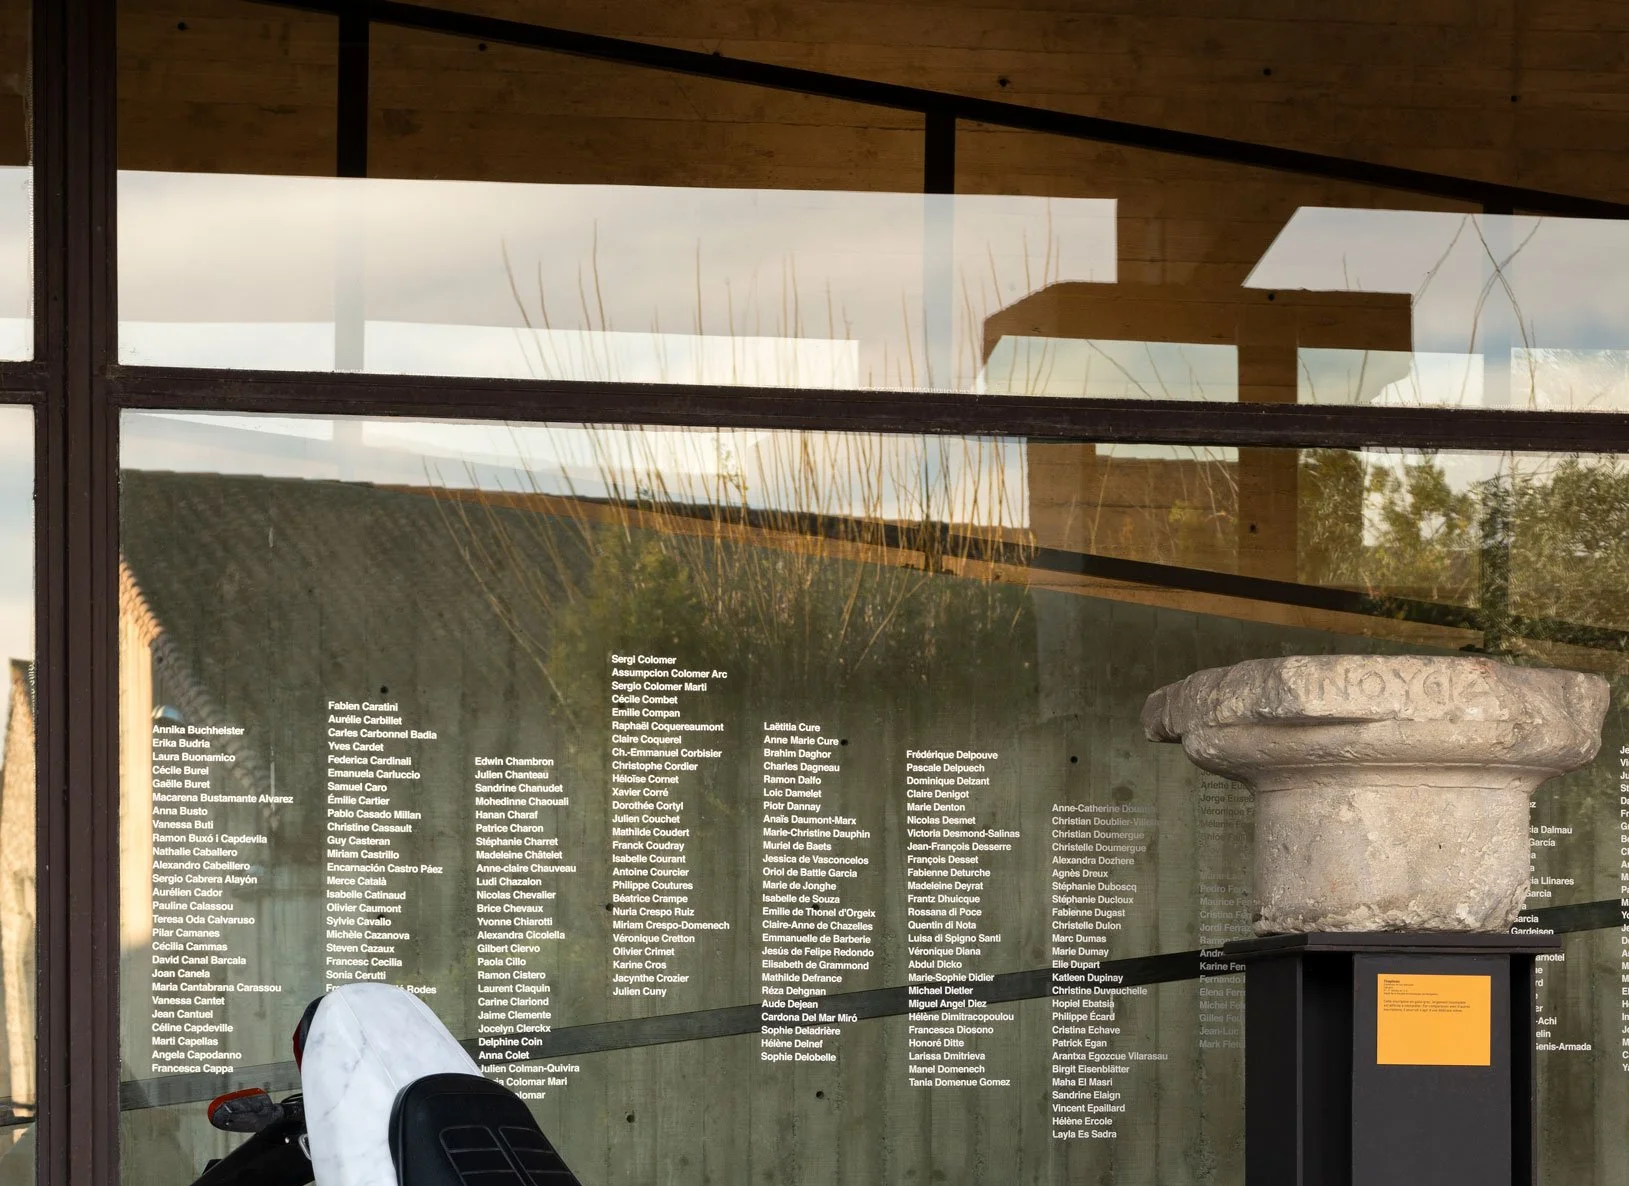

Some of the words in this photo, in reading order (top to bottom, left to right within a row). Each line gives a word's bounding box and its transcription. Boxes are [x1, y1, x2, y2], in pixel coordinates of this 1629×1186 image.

[612, 655, 635, 665] Sergi
[638, 656, 676, 664] Colomer
[612, 682, 641, 692] Sergio
[644, 683, 682, 691] Colomer
[685, 683, 707, 691] Marti
[328, 702, 360, 710] Fabien
[362, 702, 398, 711] Caratini
[153, 725, 185, 734] Annika
[188, 726, 244, 735] Buchheister
[612, 722, 649, 732] Raphaël
[651, 722, 724, 733] Coquereaumont
[764, 736, 788, 744] Anne
[791, 737, 815, 745] Marie
[153, 752, 179, 761] Laura
[182, 753, 235, 762] Buonamico
[612, 748, 678, 757] Ch.-Emmanuel
[681, 749, 722, 757] Corbisier
[907, 751, 954, 760] Frédérique
[957, 751, 998, 761] Delpouve
[328, 756, 368, 764] Federica
[370, 756, 411, 765] Cardinali
[475, 757, 503, 765] Edwin
[506, 758, 554, 766] Chambron
[764, 763, 798, 771] Charles
[801, 763, 839, 773] Dagneau
[153, 779, 182, 788] Gaëlle
[185, 780, 210, 788] Buret
[613, 775, 646, 783] Héloïse
[648, 775, 679, 783] Cornet
[907, 777, 955, 786] Dominique
[957, 777, 989, 785] Delzant
[328, 782, 362, 791] Samuel
[365, 783, 387, 791] Caro
[475, 784, 516, 792] Sandrine
[519, 784, 563, 792] Chanudet
[153, 793, 198, 802] Macarena
[201, 794, 257, 803] Bustamante
[259, 795, 293, 803] Alvarez
[763, 815, 789, 823] Anaïs
[792, 816, 856, 825] Daumont-Marx
[943, 817, 976, 825] Desmet
[328, 822, 369, 832] Christine
[372, 823, 412, 832] Cassault
[1541, 826, 1572, 834] Dalmau
[1052, 830, 1091, 838] Christian
[476, 837, 522, 847] Stéphanie
[524, 838, 558, 846] Charret
[613, 841, 643, 849] Franck
[646, 842, 684, 851] Coudray
[153, 847, 190, 855] Nathalie
[193, 848, 237, 856] Caballero
[907, 843, 970, 852] Jean-François
[972, 843, 1011, 851] Desserre
[763, 855, 796, 863] Jessica
[799, 855, 810, 863] de
[813, 856, 869, 864] Vasconcelos
[327, 863, 385, 872] Encarnación
[388, 864, 418, 873] Castro
[1053, 869, 1080, 878] Agnès
[1541, 877, 1574, 885] Llinares
[613, 881, 649, 891] Philippe
[652, 881, 693, 890] Coutures
[1052, 882, 1095, 891] Stéphanie
[1098, 882, 1136, 892] Duboscq
[153, 888, 191, 897] Aurélien
[194, 888, 223, 897] Cador
[477, 891, 510, 899] Nicolas
[513, 891, 556, 899] Chevalier
[327, 903, 356, 912] Olivier
[359, 904, 401, 912] Caumont
[908, 908, 946, 916] Rossana
[949, 908, 957, 916] di
[960, 908, 982, 916] Poce
[639, 908, 672, 917] Crespo
[675, 908, 694, 916] Ruiz
[763, 908, 790, 916] Emilie
[792, 908, 803, 916] de
[806, 908, 836, 917] Thonel
[839, 909, 875, 919] d'Orgeix
[153, 915, 183, 924] Teresa
[186, 916, 205, 924] Oda
[208, 916, 255, 924] Calvaruso
[326, 930, 362, 939] Michèle
[365, 931, 410, 940] Cazanova
[613, 934, 659, 944] Véronique
[662, 934, 695, 942] Cretton
[478, 944, 508, 953] Gilbert
[762, 947, 789, 956] Jesús
[791, 948, 802, 956] de
[805, 948, 831, 958] Felipe
[834, 949, 874, 957] Redondo
[909, 947, 953, 956] Véronique
[956, 947, 981, 956] Diana
[152, 956, 179, 964] David
[181, 956, 208, 965] Canal
[211, 957, 246, 965] Barcala
[1071, 960, 1100, 970] Dupart
[1200, 961, 1228, 970] Karine
[326, 970, 352, 979] Sonia
[355, 971, 386, 980] Cerutti
[478, 971, 510, 979] Ramon
[1053, 973, 1085, 981] Katleen
[1087, 974, 1123, 983] Dupinay
[613, 987, 640, 995] Julien
[643, 987, 666, 997] Cuny
[909, 986, 942, 995] Michael
[478, 1011, 505, 1019] Jaime
[508, 1011, 551, 1019] Clemente
[1053, 1013, 1088, 1022] Philippe
[1090, 1011, 1115, 1021] Écard
[909, 1039, 941, 1047] Honoré
[944, 1039, 964, 1047] Ditte
[1053, 1039, 1082, 1047] Patrick
[1085, 1039, 1107, 1049] Egan
[505, 1052, 529, 1060] Colet
[762, 1052, 792, 1062] Sophie
[795, 1053, 836, 1061] Delobelle
[152, 1064, 200, 1073] Francesca
[203, 1065, 233, 1074] Cappa
[480, 1065, 506, 1073] Julien
[509, 1065, 579, 1073] Colman-Quivira
[1053, 1066, 1076, 1075] Birgit
[1078, 1065, 1130, 1074] Eisenblätter
[507, 1078, 545, 1086] Colomar
[548, 1078, 567, 1086] Mari
[910, 1078, 932, 1086] Tania
[980, 1078, 1010, 1087] Gomez
[515, 1091, 545, 1099] olomar
[1053, 1130, 1076, 1140] Layla
